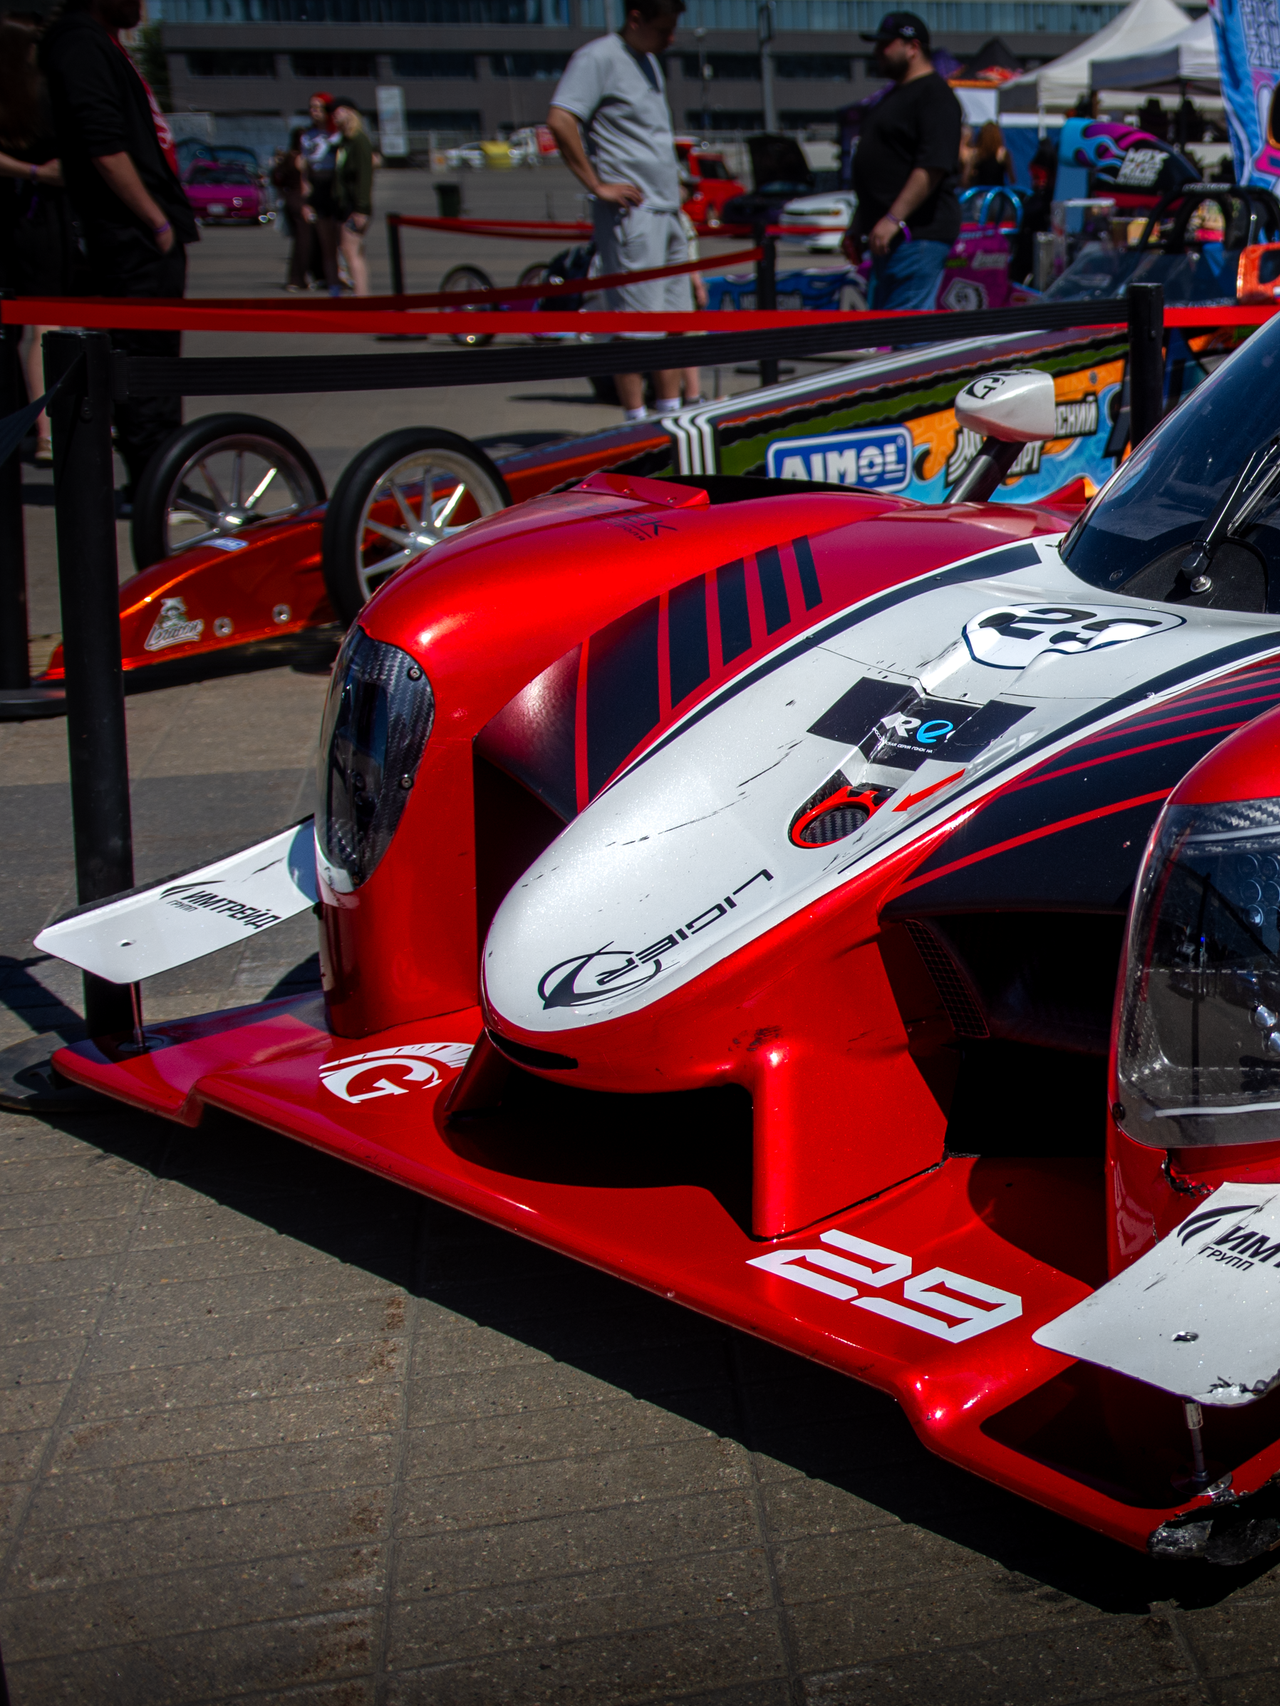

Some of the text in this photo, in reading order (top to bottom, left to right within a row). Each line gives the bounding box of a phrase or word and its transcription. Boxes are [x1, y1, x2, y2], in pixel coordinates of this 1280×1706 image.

[780, 441, 906, 485] AIMOL
[180, 890, 282, 930] ИМТРЕЙД
[595, 868, 775, 987] LIGIER
[1198, 1246, 1255, 1272] ГРУПП
[745, 1228, 1024, 1344] 29
